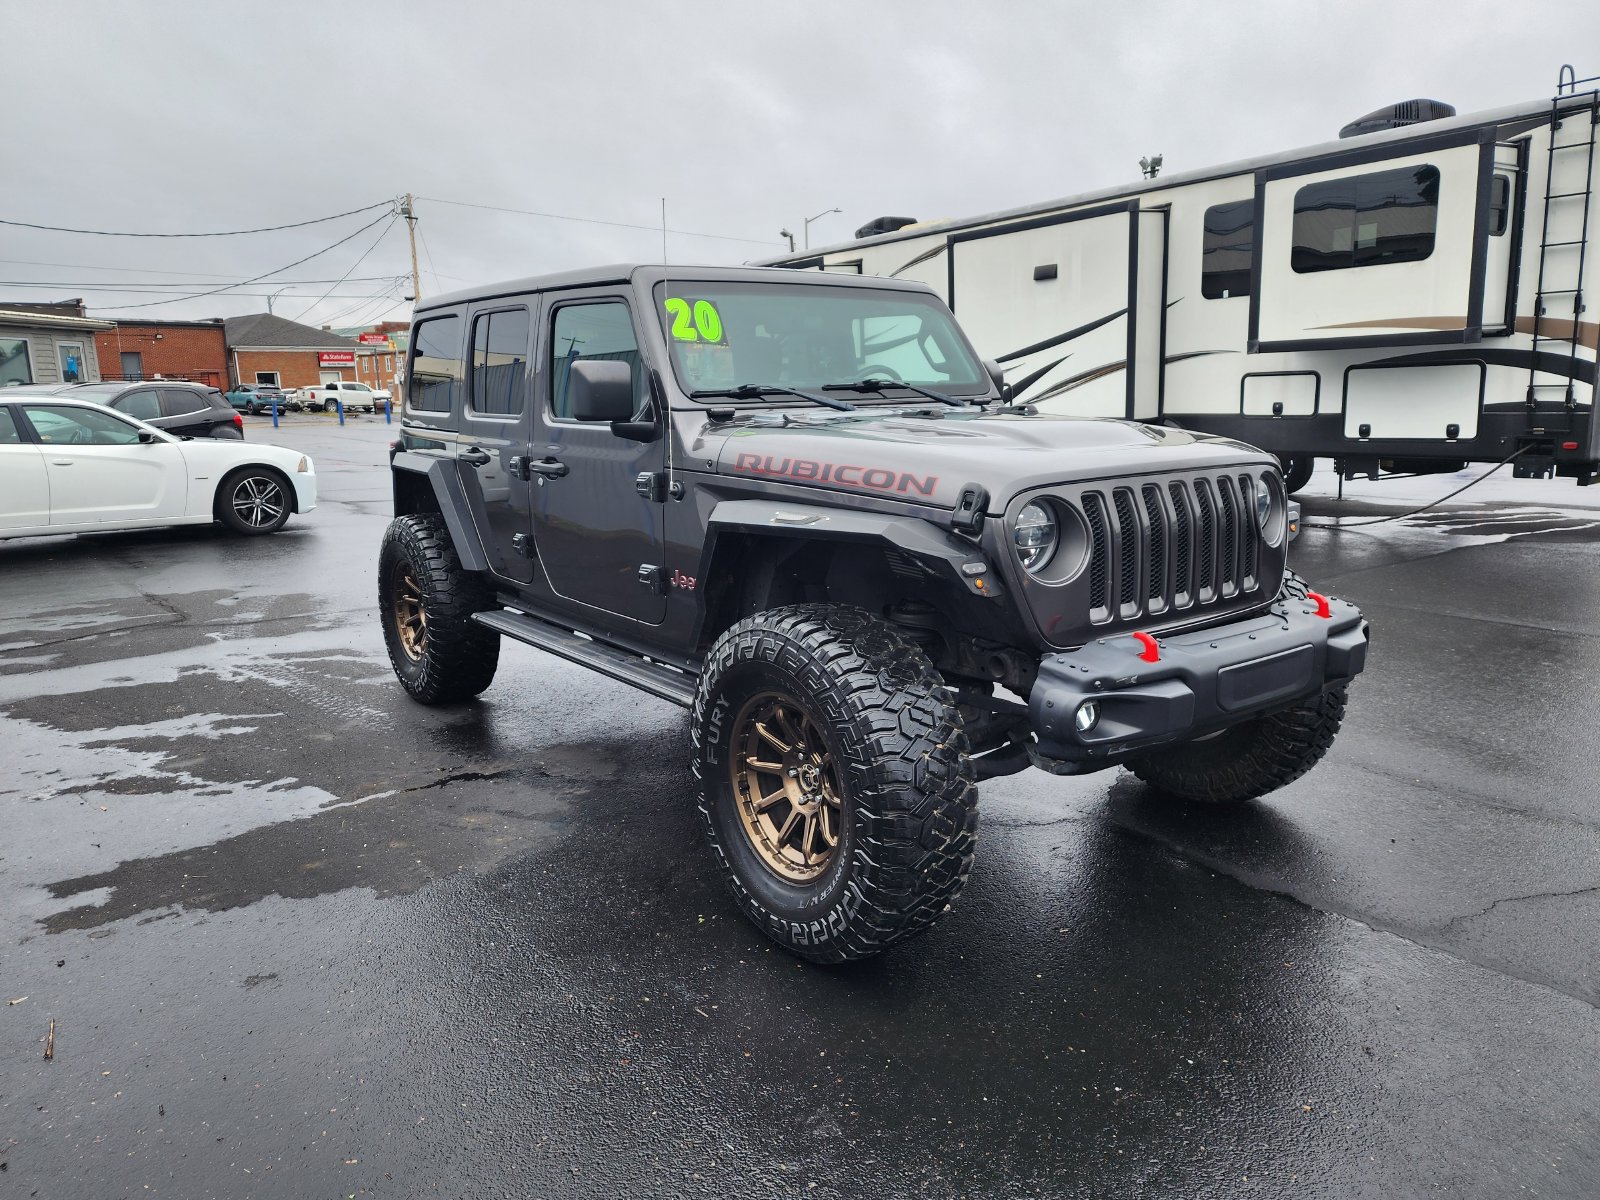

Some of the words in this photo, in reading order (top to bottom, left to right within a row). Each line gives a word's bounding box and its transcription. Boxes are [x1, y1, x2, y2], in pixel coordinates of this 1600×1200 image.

[665, 297, 723, 343] 20
[734, 451, 939, 497] RUBICON
[670, 569, 697, 591] Jee
[706, 692, 731, 765] FURY
